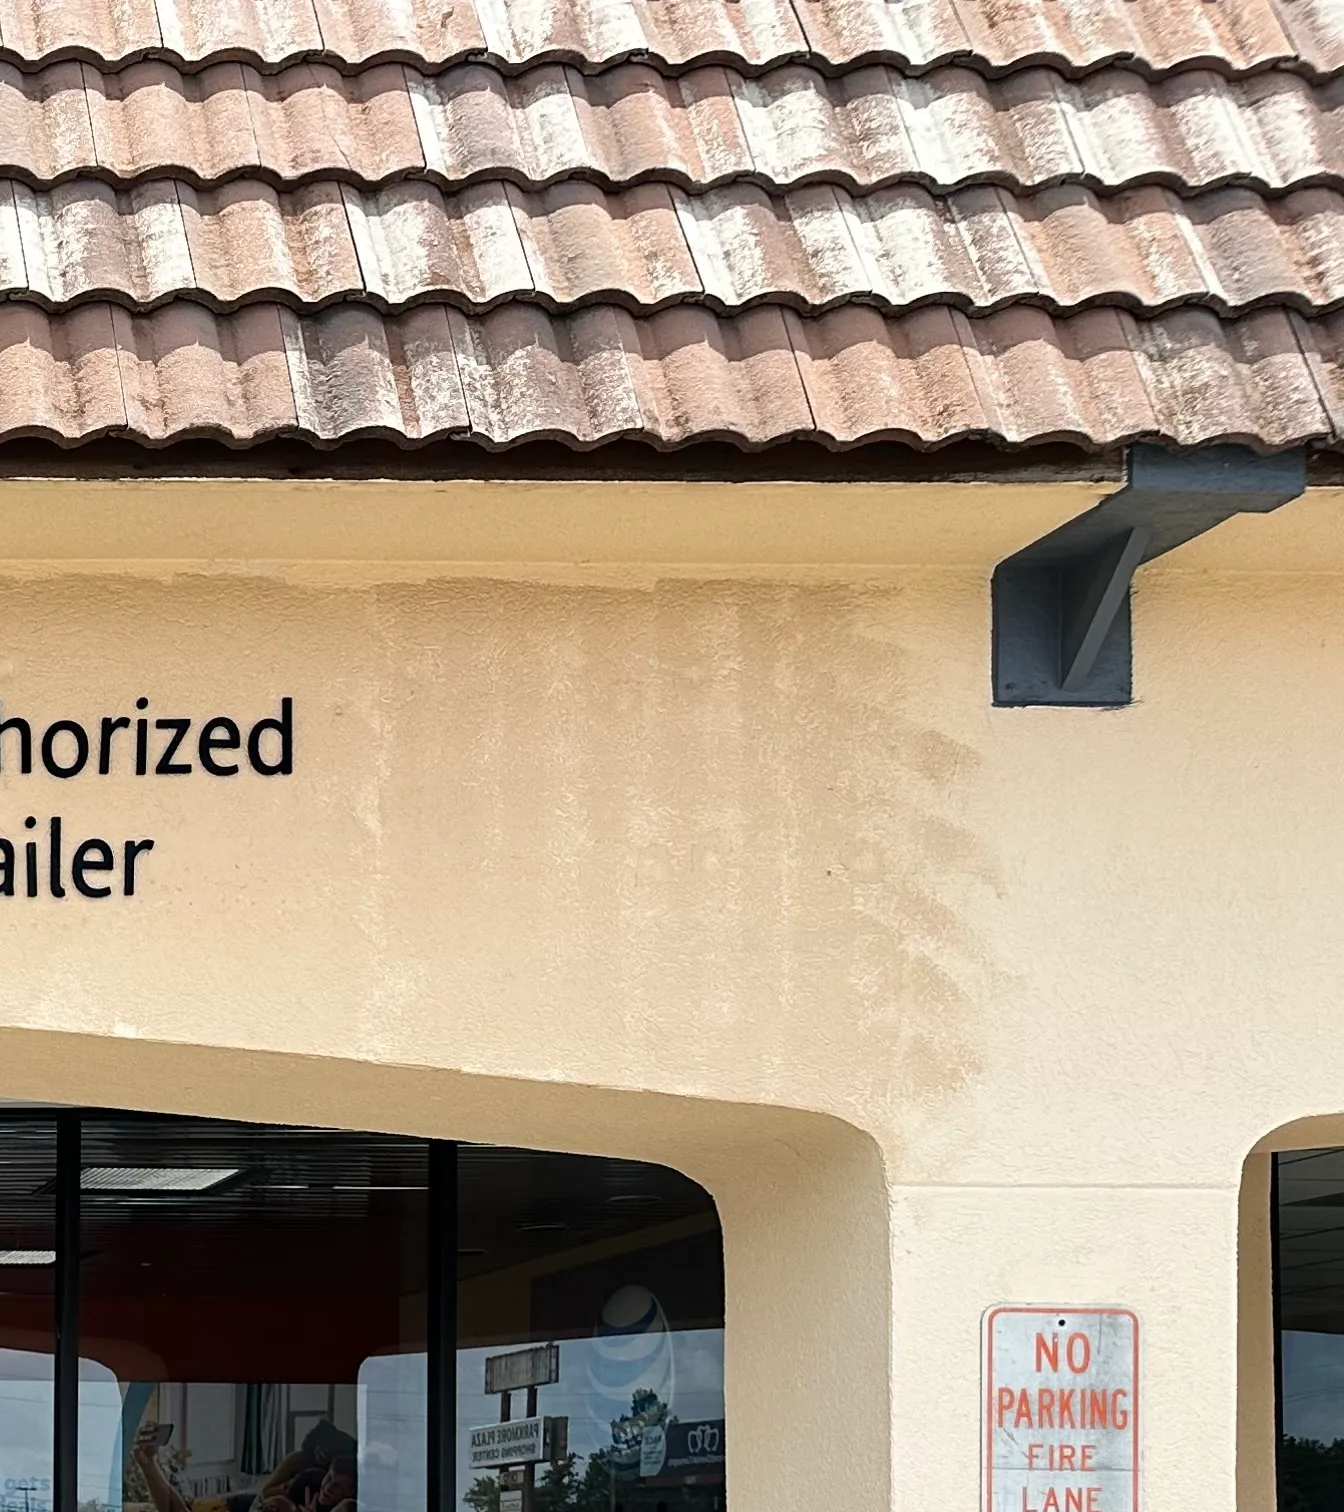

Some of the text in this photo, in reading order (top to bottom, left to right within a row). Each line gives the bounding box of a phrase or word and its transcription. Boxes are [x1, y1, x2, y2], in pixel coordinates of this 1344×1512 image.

[1034, 1331, 1092, 1375] NO
[996, 1387, 1129, 1431] PARKING
[1027, 1443, 1098, 1472] FIRE
[4, 1475, 51, 1497] gets
